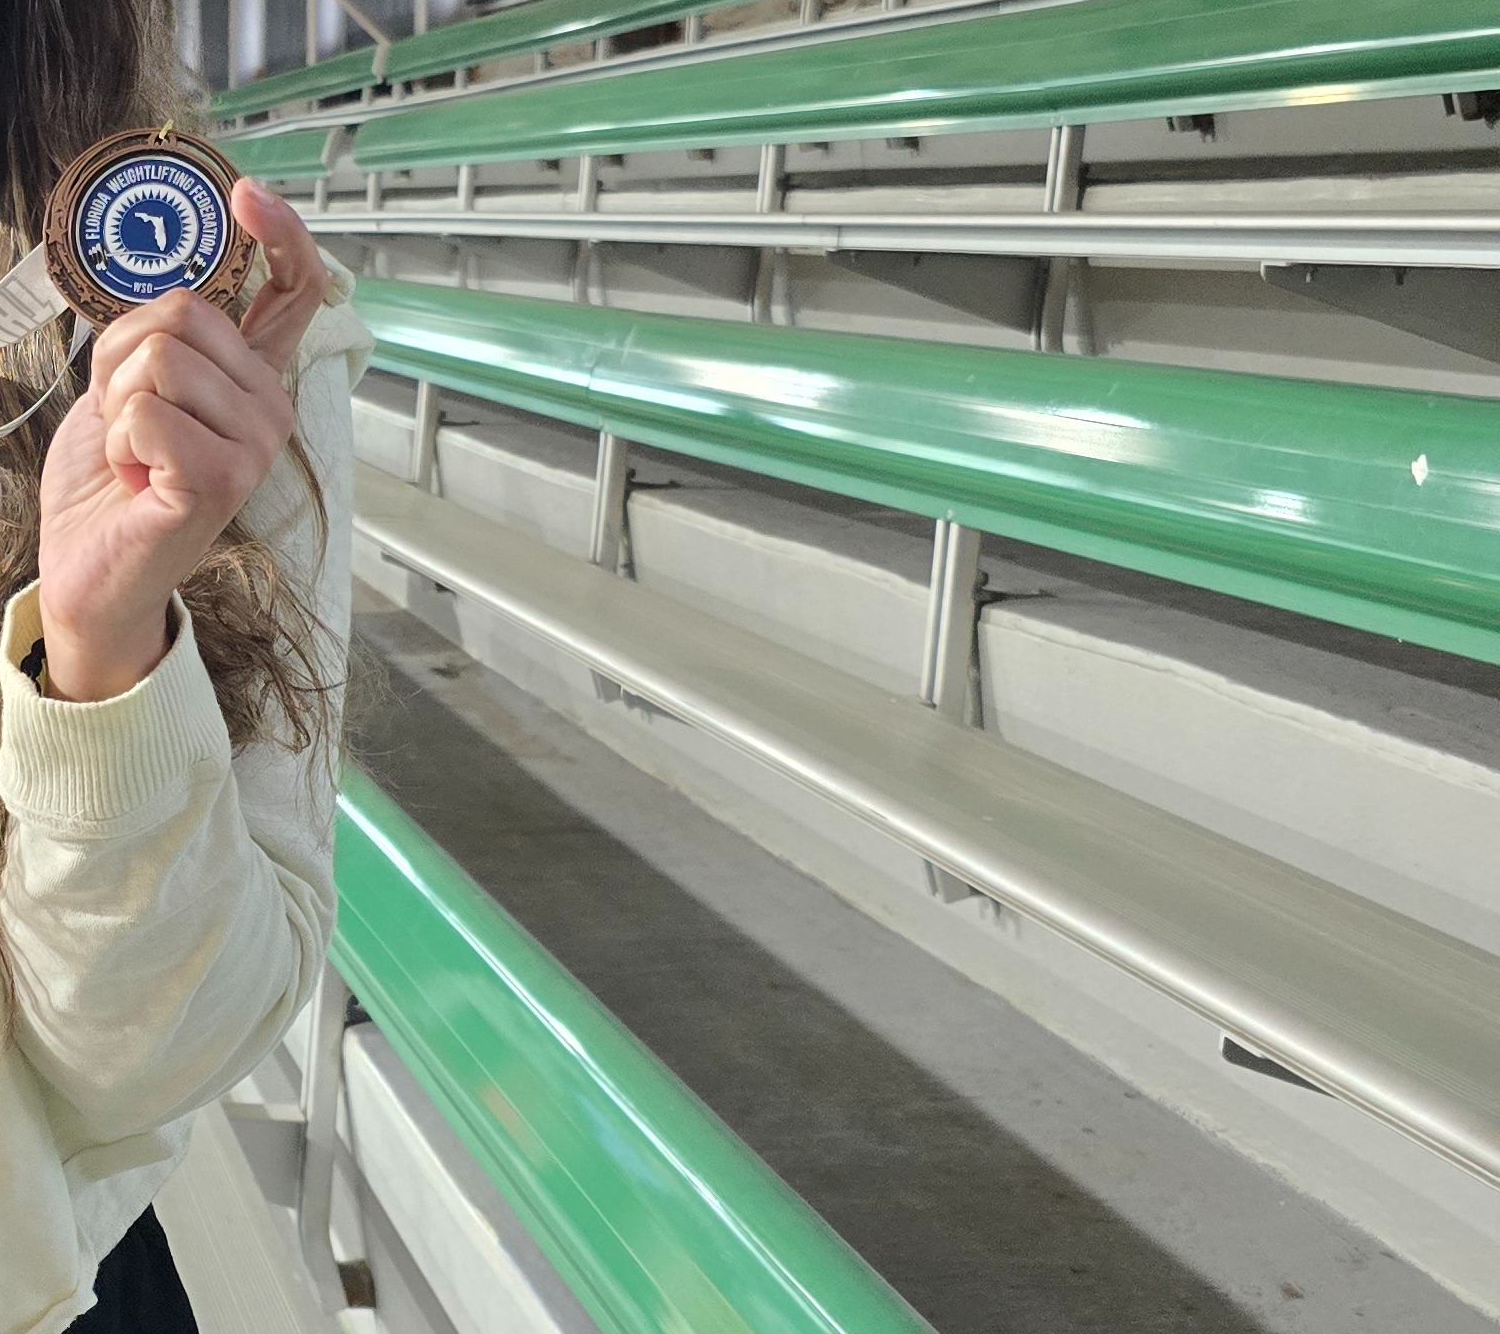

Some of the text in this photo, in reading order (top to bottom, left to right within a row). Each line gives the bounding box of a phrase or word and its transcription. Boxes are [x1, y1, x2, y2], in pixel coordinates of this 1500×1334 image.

[86, 164, 218, 256] FLORIDA WEIGHTLIFTING FEDERATION
